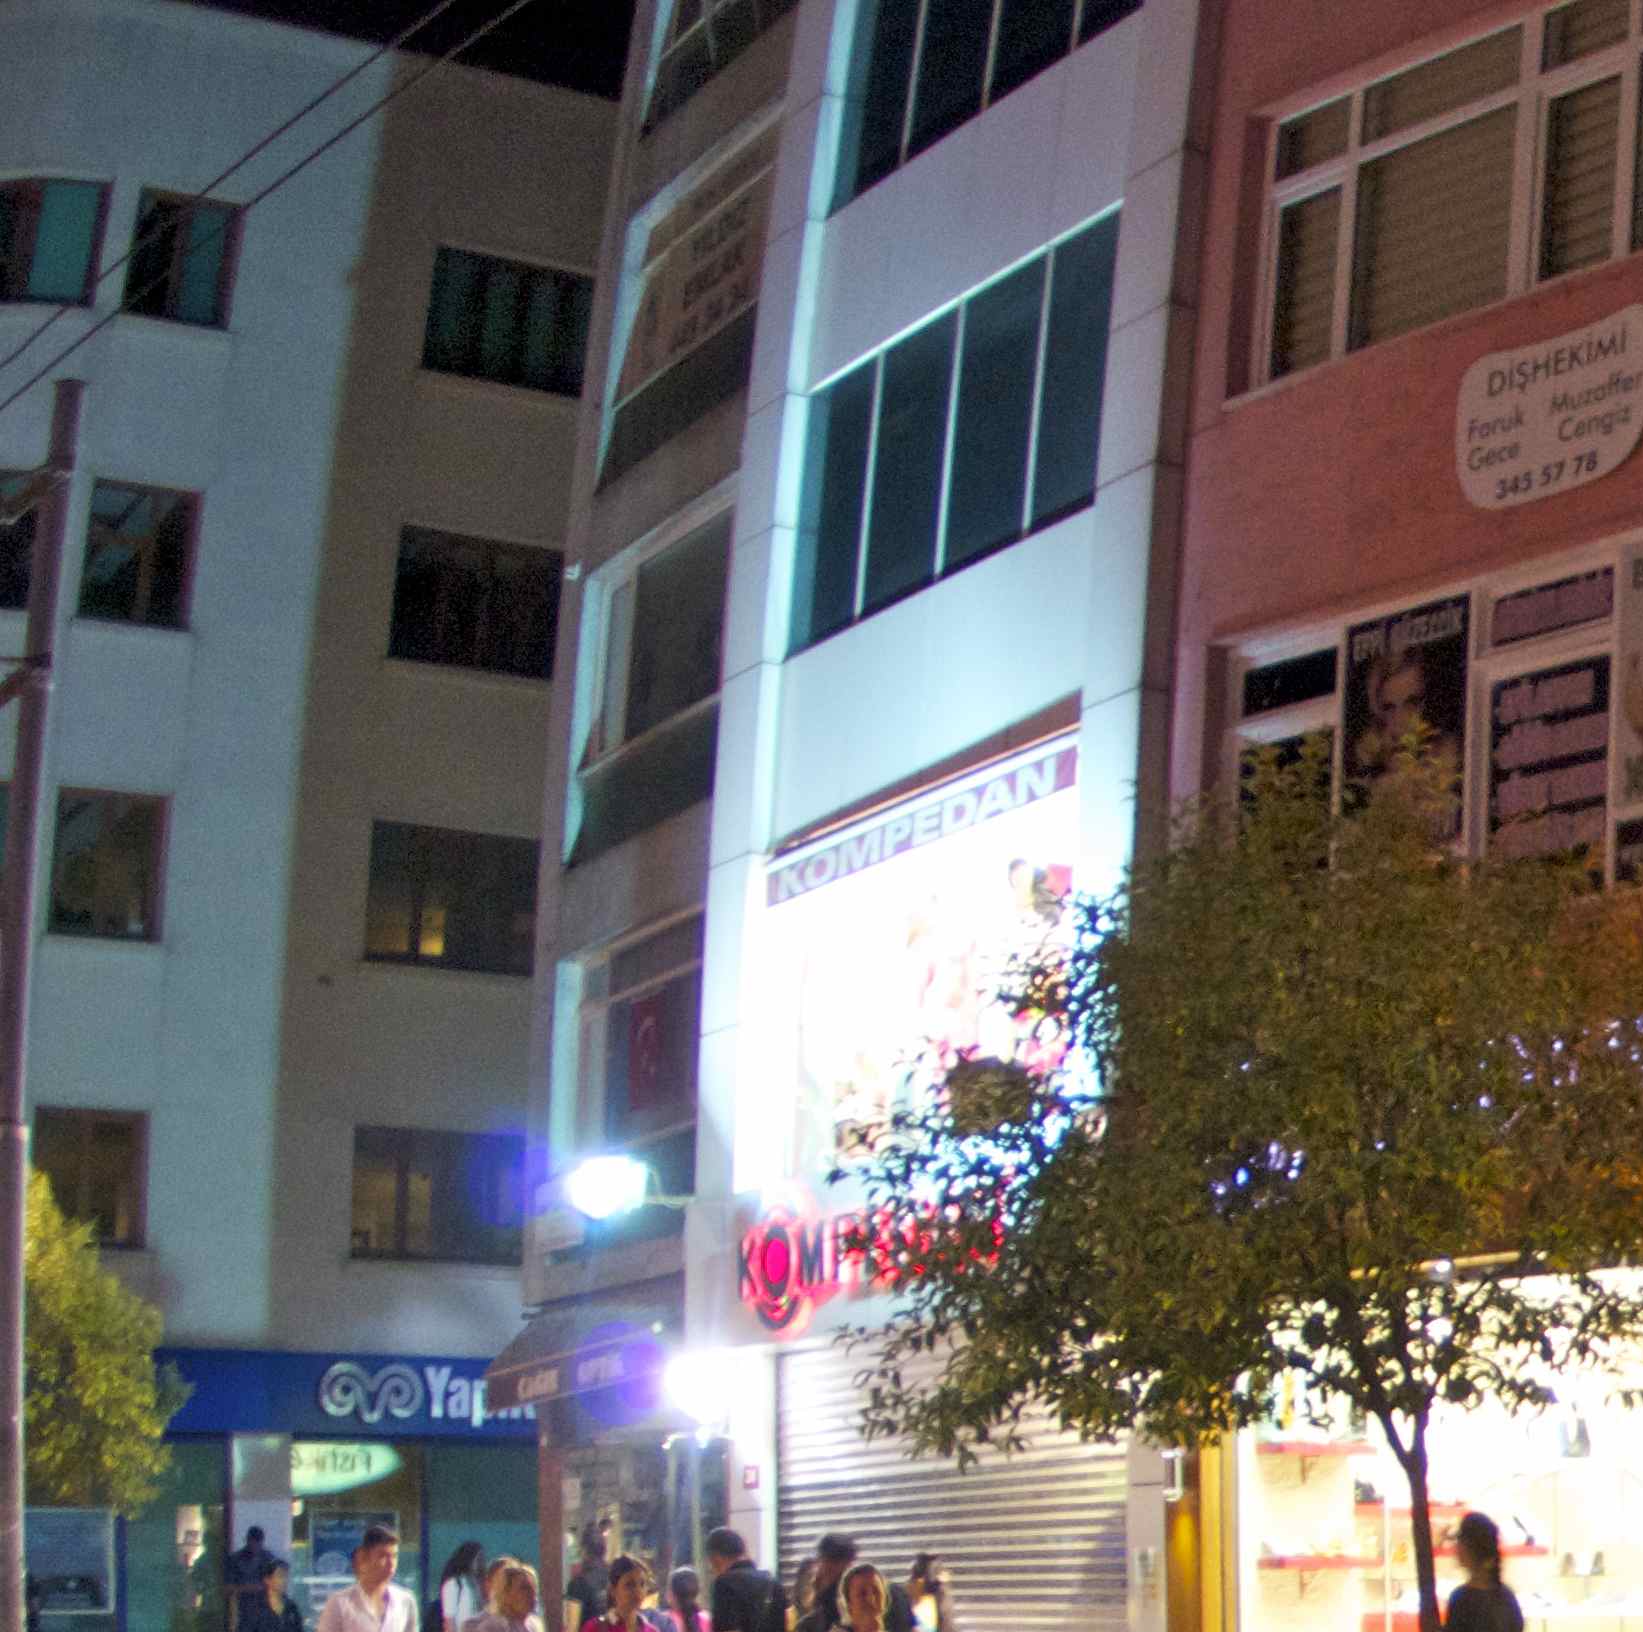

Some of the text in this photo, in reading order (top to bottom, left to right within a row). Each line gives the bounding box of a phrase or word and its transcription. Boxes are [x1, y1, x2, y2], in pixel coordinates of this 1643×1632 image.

[1495, 449, 1598, 500] 345 57 78
[776, 754, 1058, 902] KOMPEDAN
